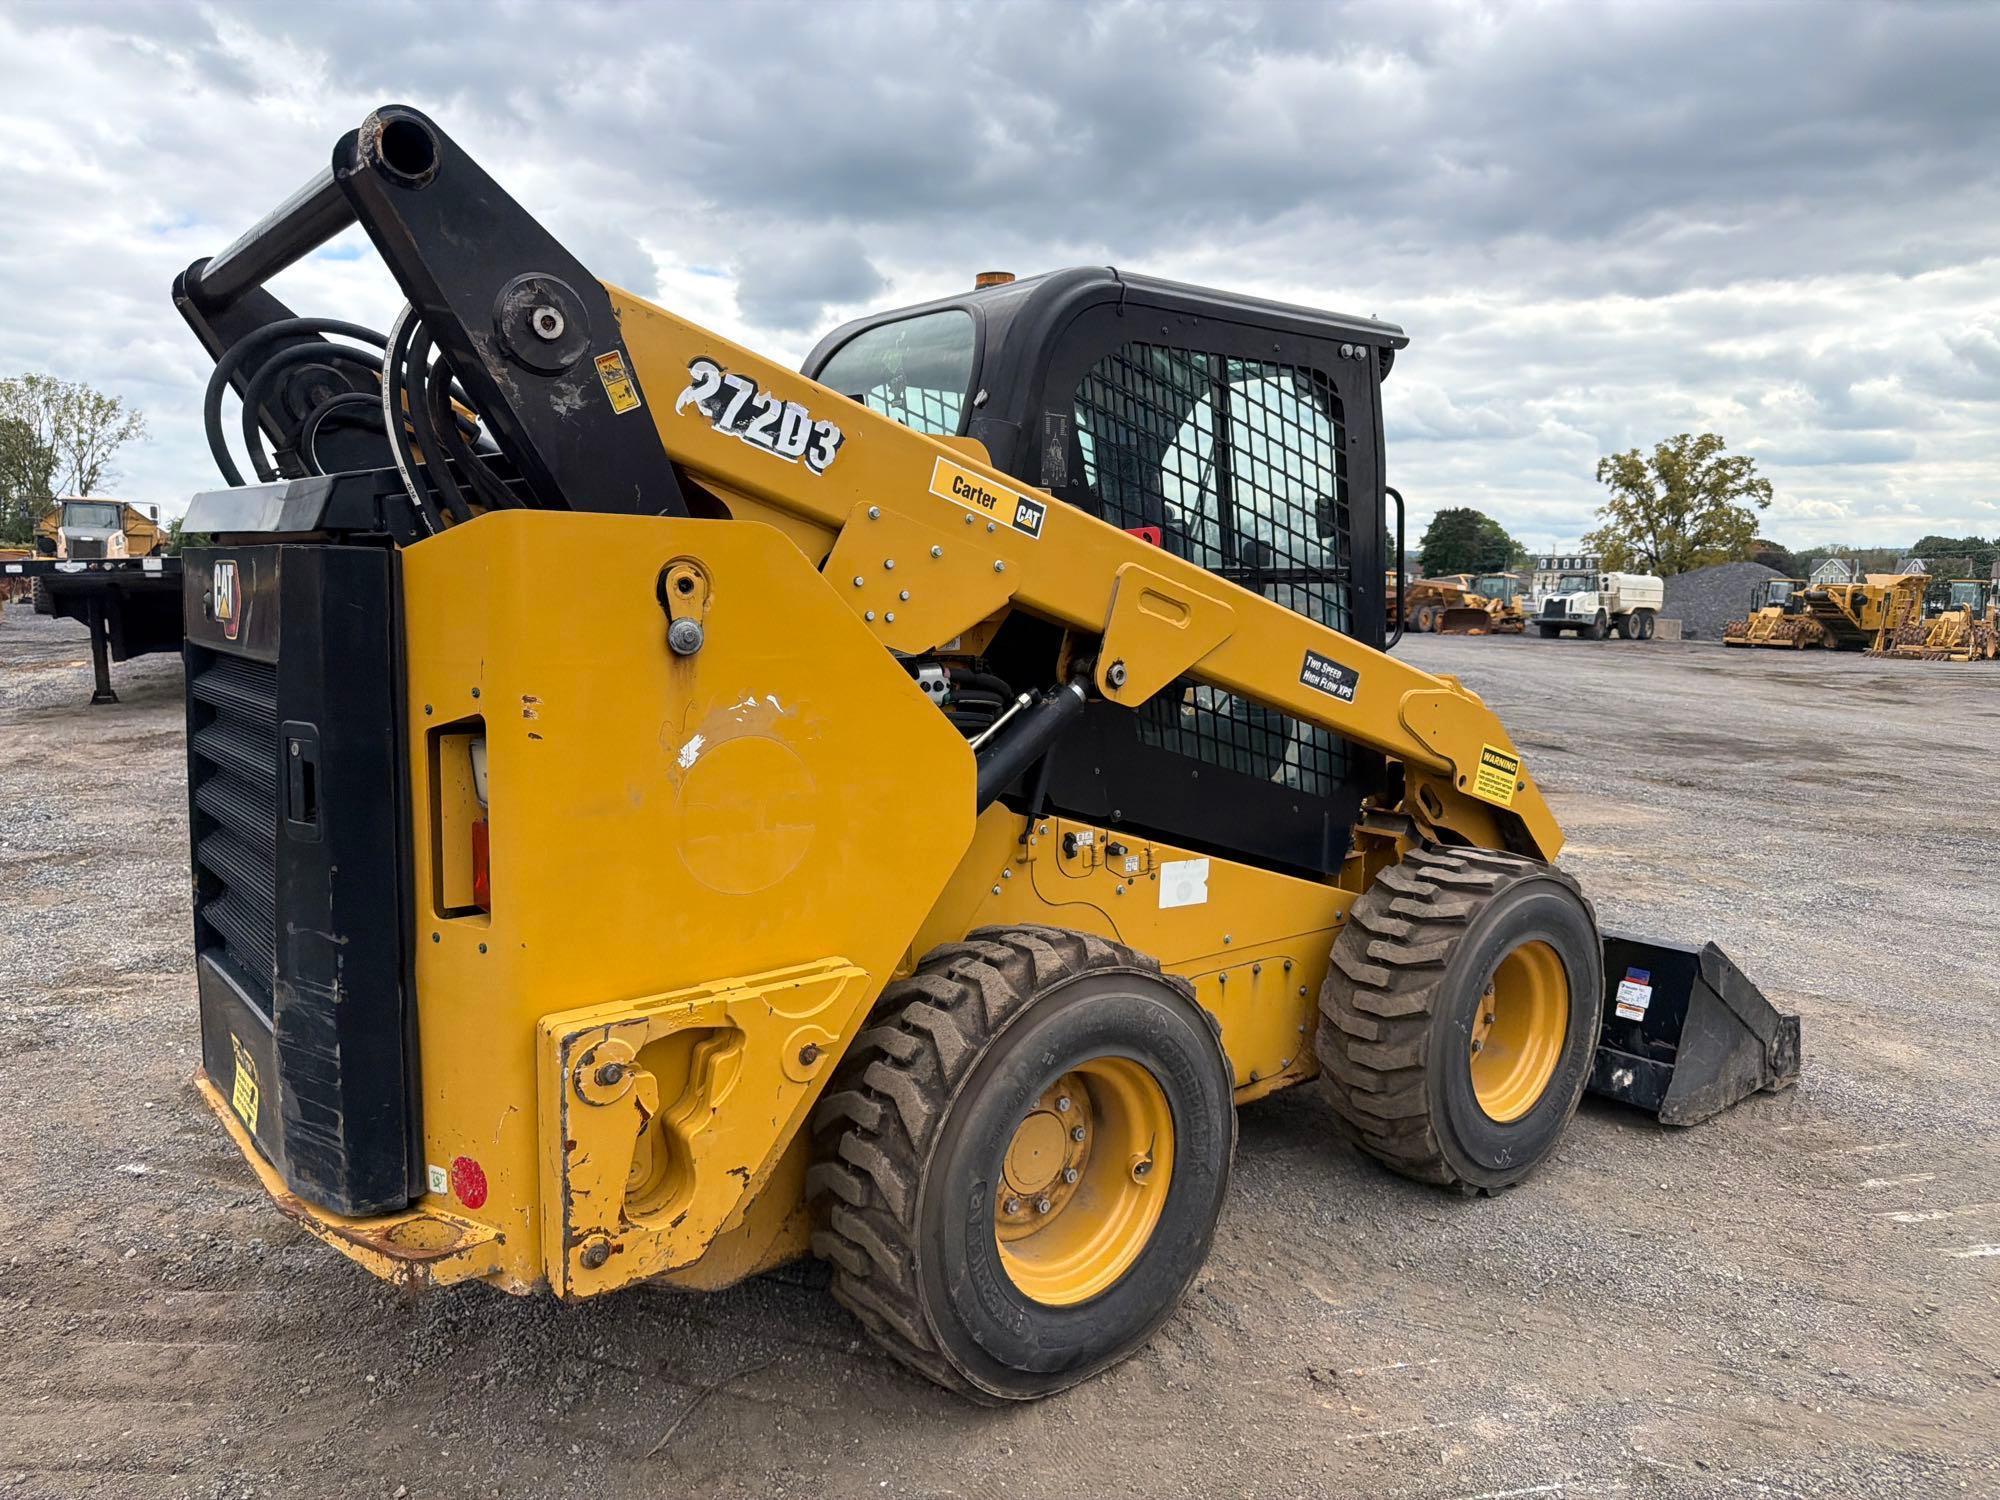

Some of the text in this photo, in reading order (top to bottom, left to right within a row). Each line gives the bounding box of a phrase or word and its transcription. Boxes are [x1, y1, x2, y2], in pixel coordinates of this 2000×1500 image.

[675, 357, 845, 475] 272D3
[952, 475, 1041, 530] Carter CAT
[214, 564, 233, 617] CAT
[1337, 684, 1352, 697] XPS
[1483, 752, 1516, 771] WARNING
